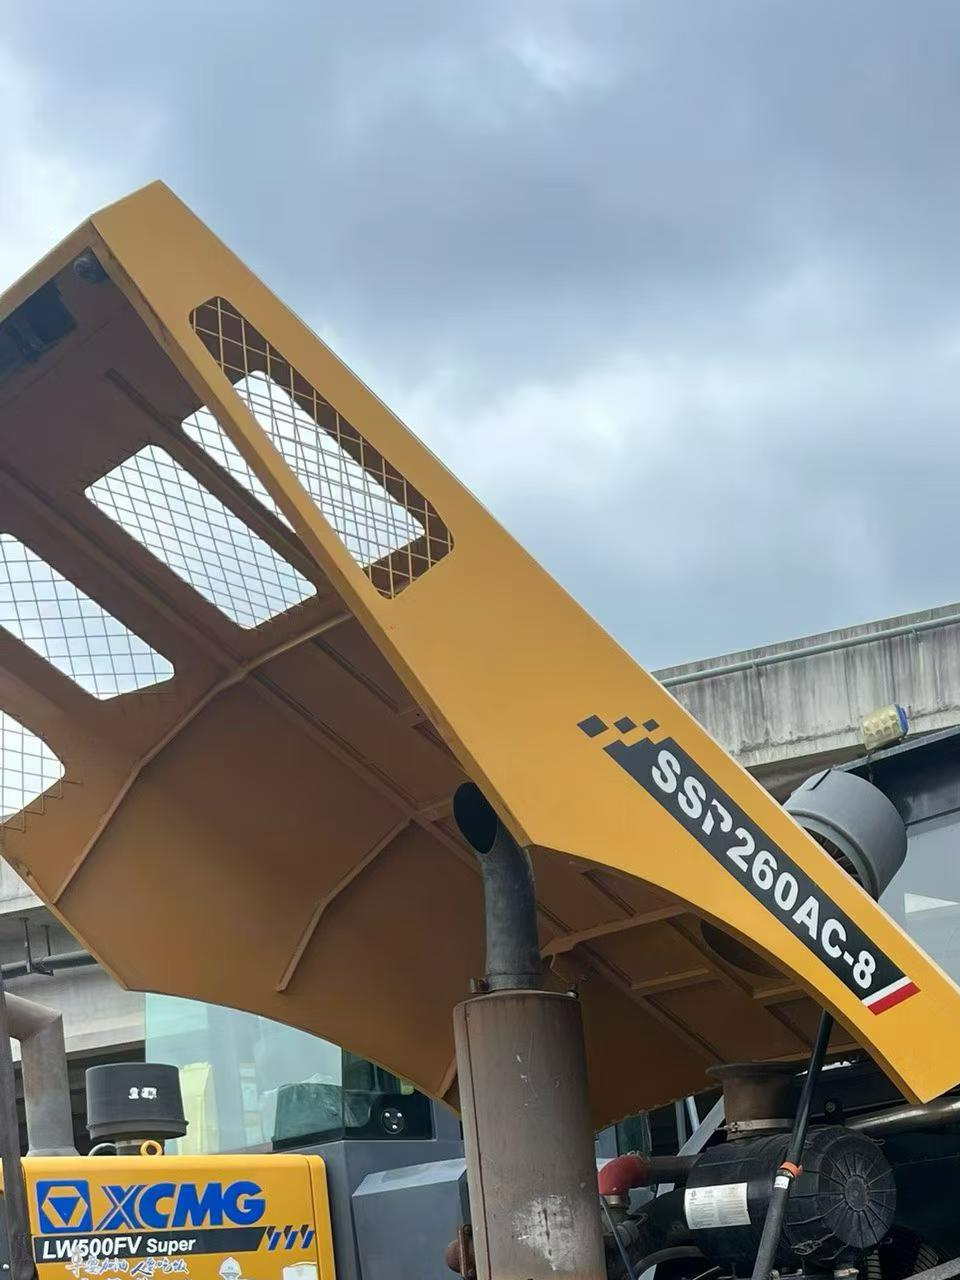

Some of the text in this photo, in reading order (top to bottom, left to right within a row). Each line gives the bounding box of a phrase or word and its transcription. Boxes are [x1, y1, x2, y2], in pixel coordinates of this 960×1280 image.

[95, 1181, 266, 1232] XCMG
[42, 1236, 196, 1260] LW500FV Super
